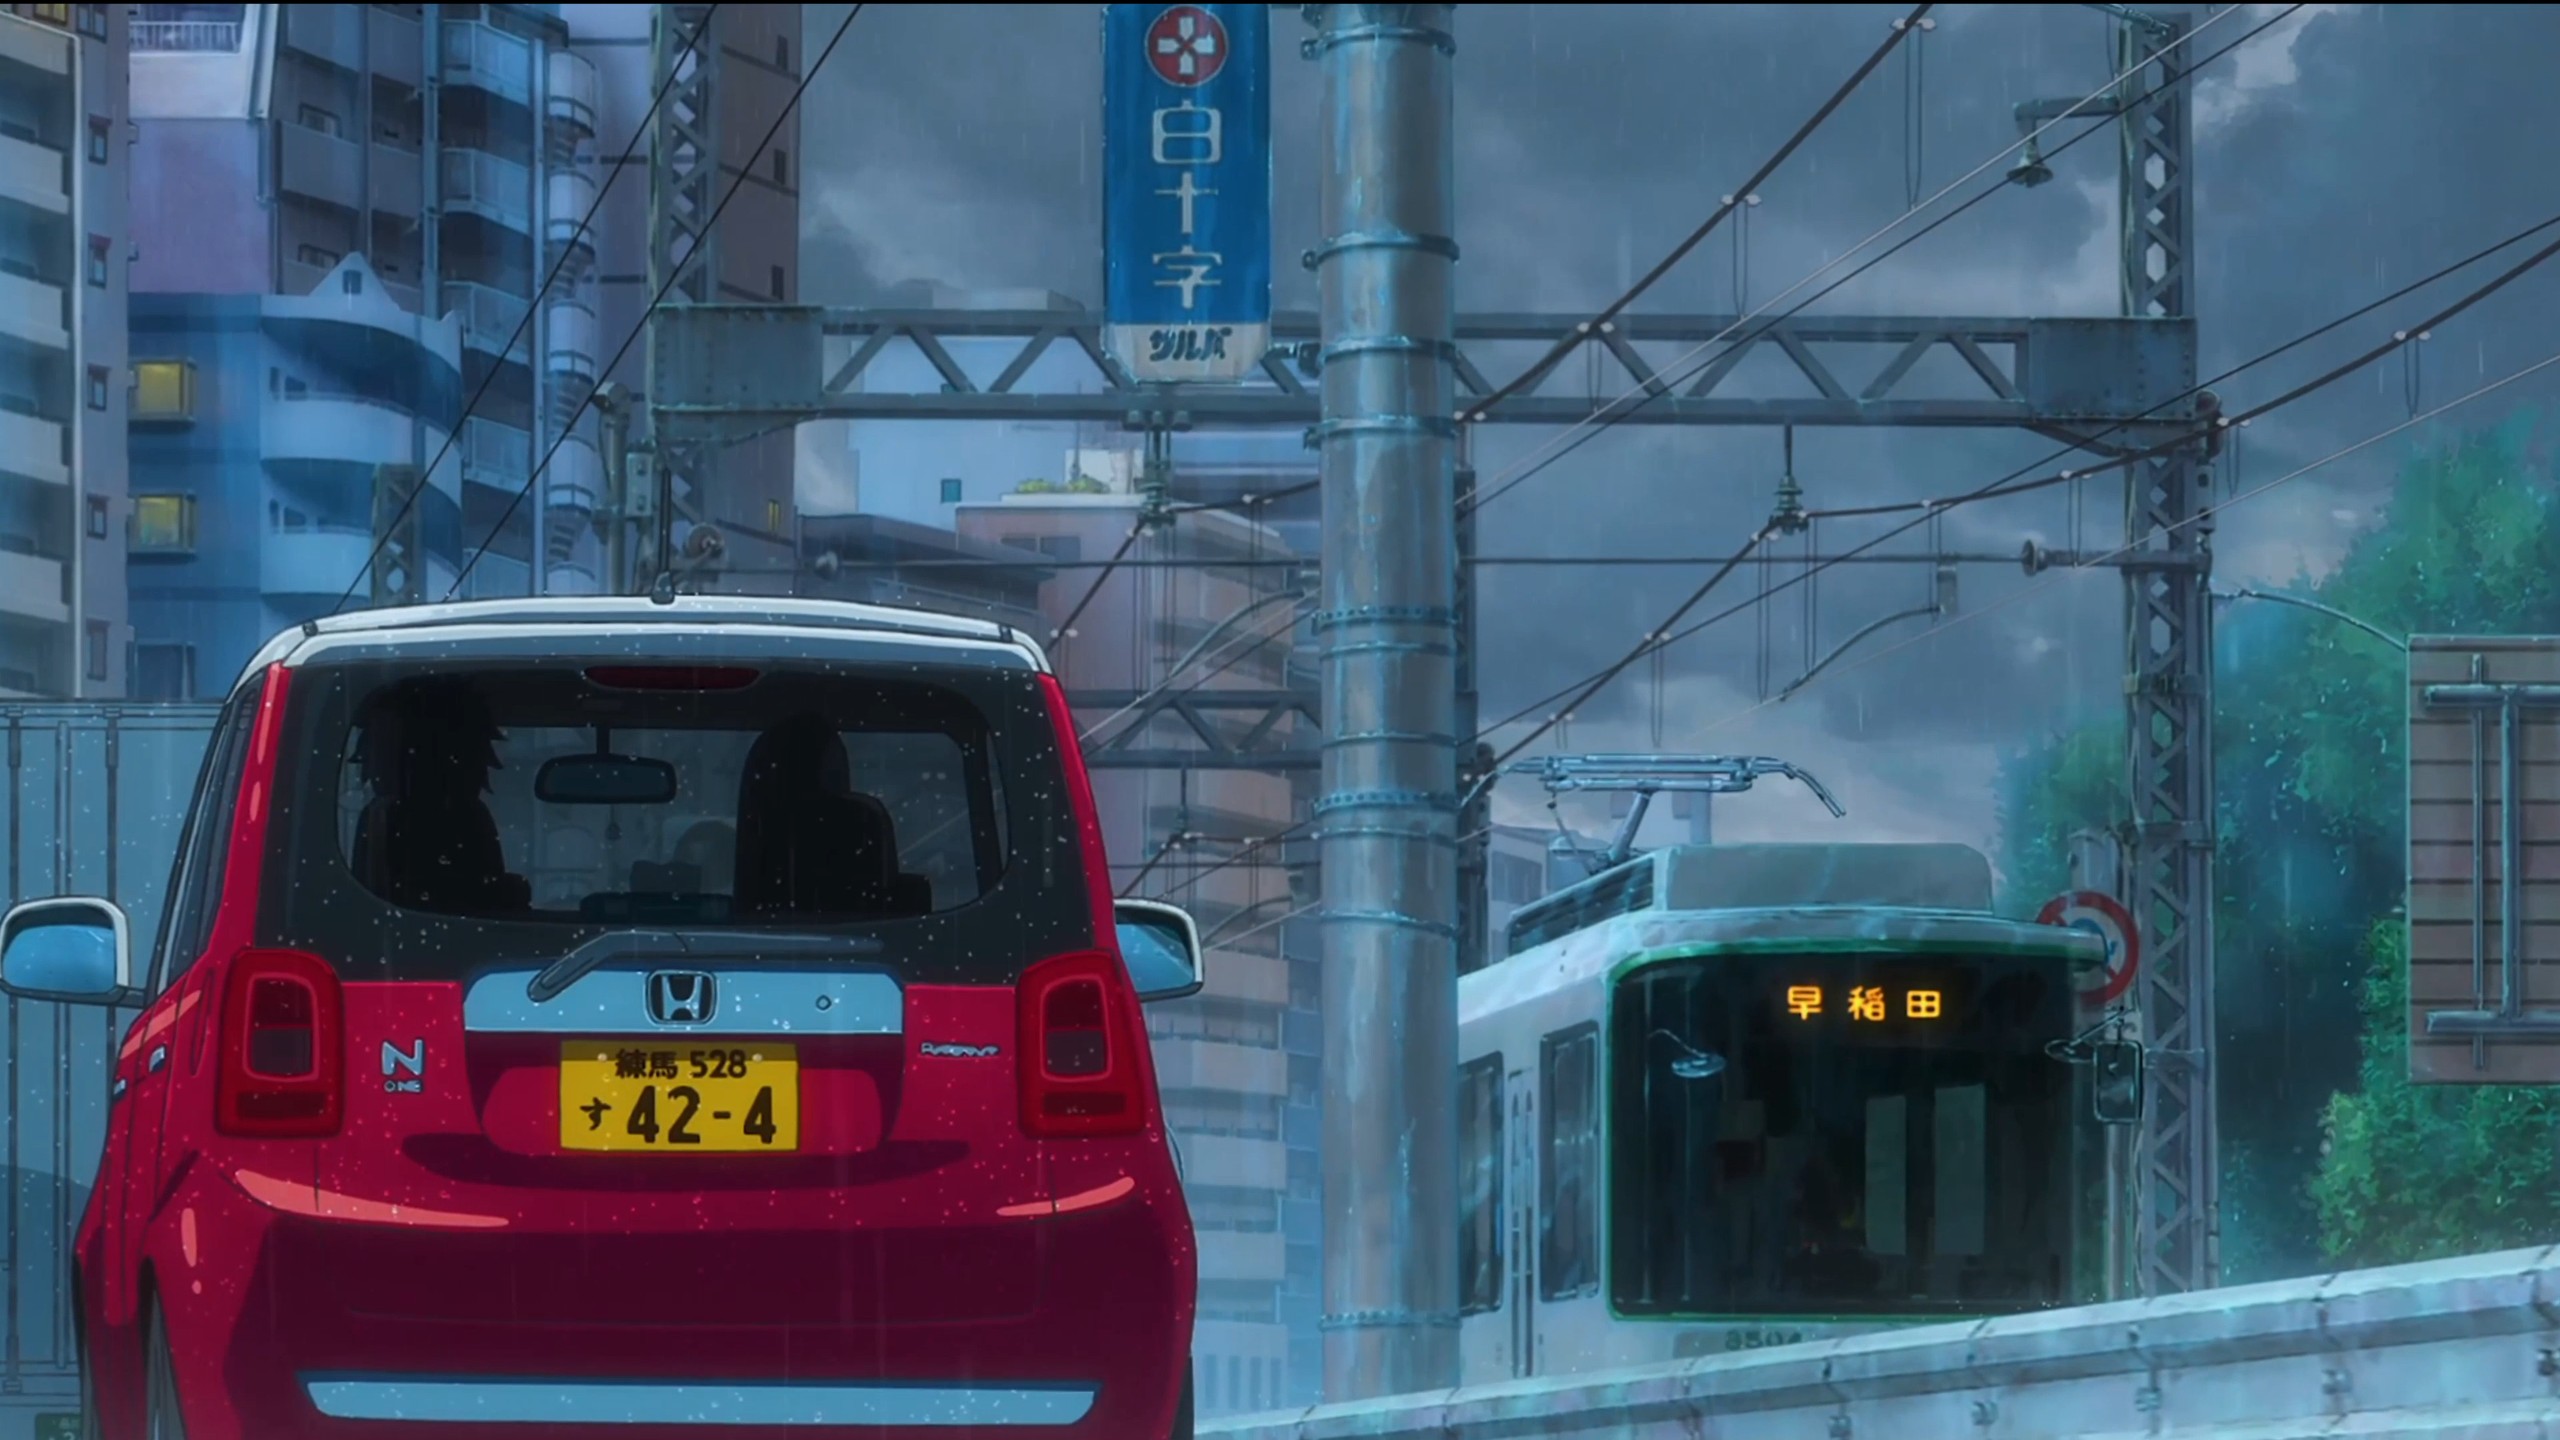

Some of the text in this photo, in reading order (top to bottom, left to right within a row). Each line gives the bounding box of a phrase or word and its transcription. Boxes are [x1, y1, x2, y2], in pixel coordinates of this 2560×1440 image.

[1152, 99, 1222, 309] 白十字
[1787, 985, 1941, 1021] 早稲田
[381, 1038, 423, 1076] N
[615, 1048, 747, 1079] 練馬 528
[579, 1085, 777, 1144] す 42-4
